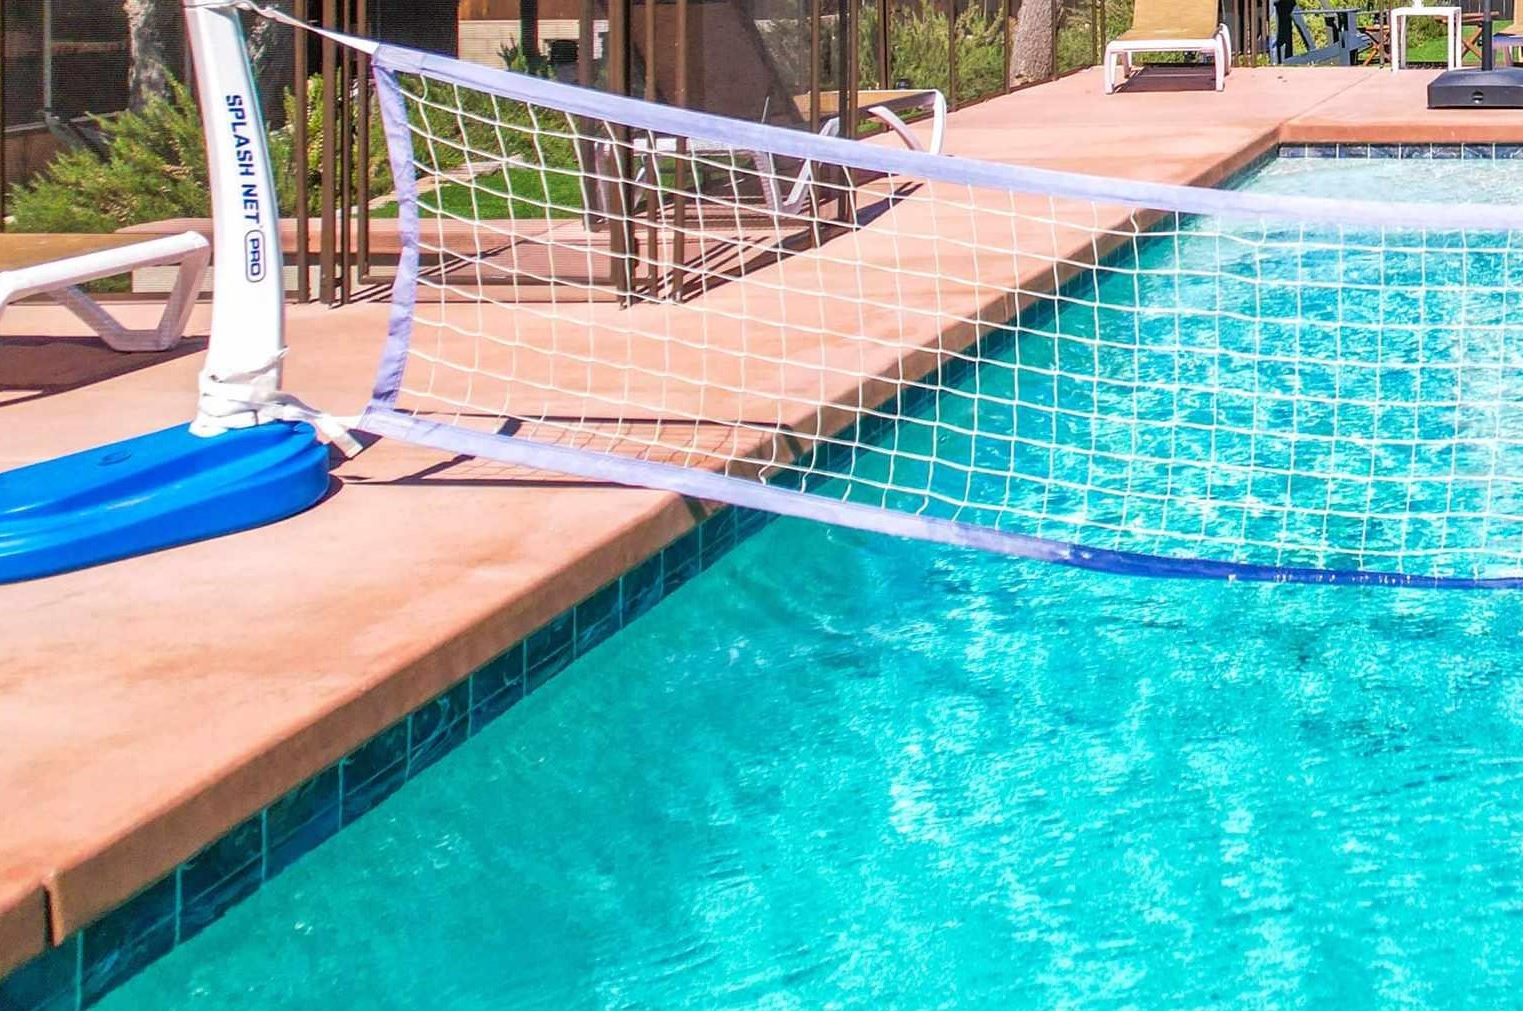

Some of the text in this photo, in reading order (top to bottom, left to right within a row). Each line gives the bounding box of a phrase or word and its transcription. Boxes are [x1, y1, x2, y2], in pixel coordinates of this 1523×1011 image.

[226, 94, 261, 277] SPLASH NET PRO
